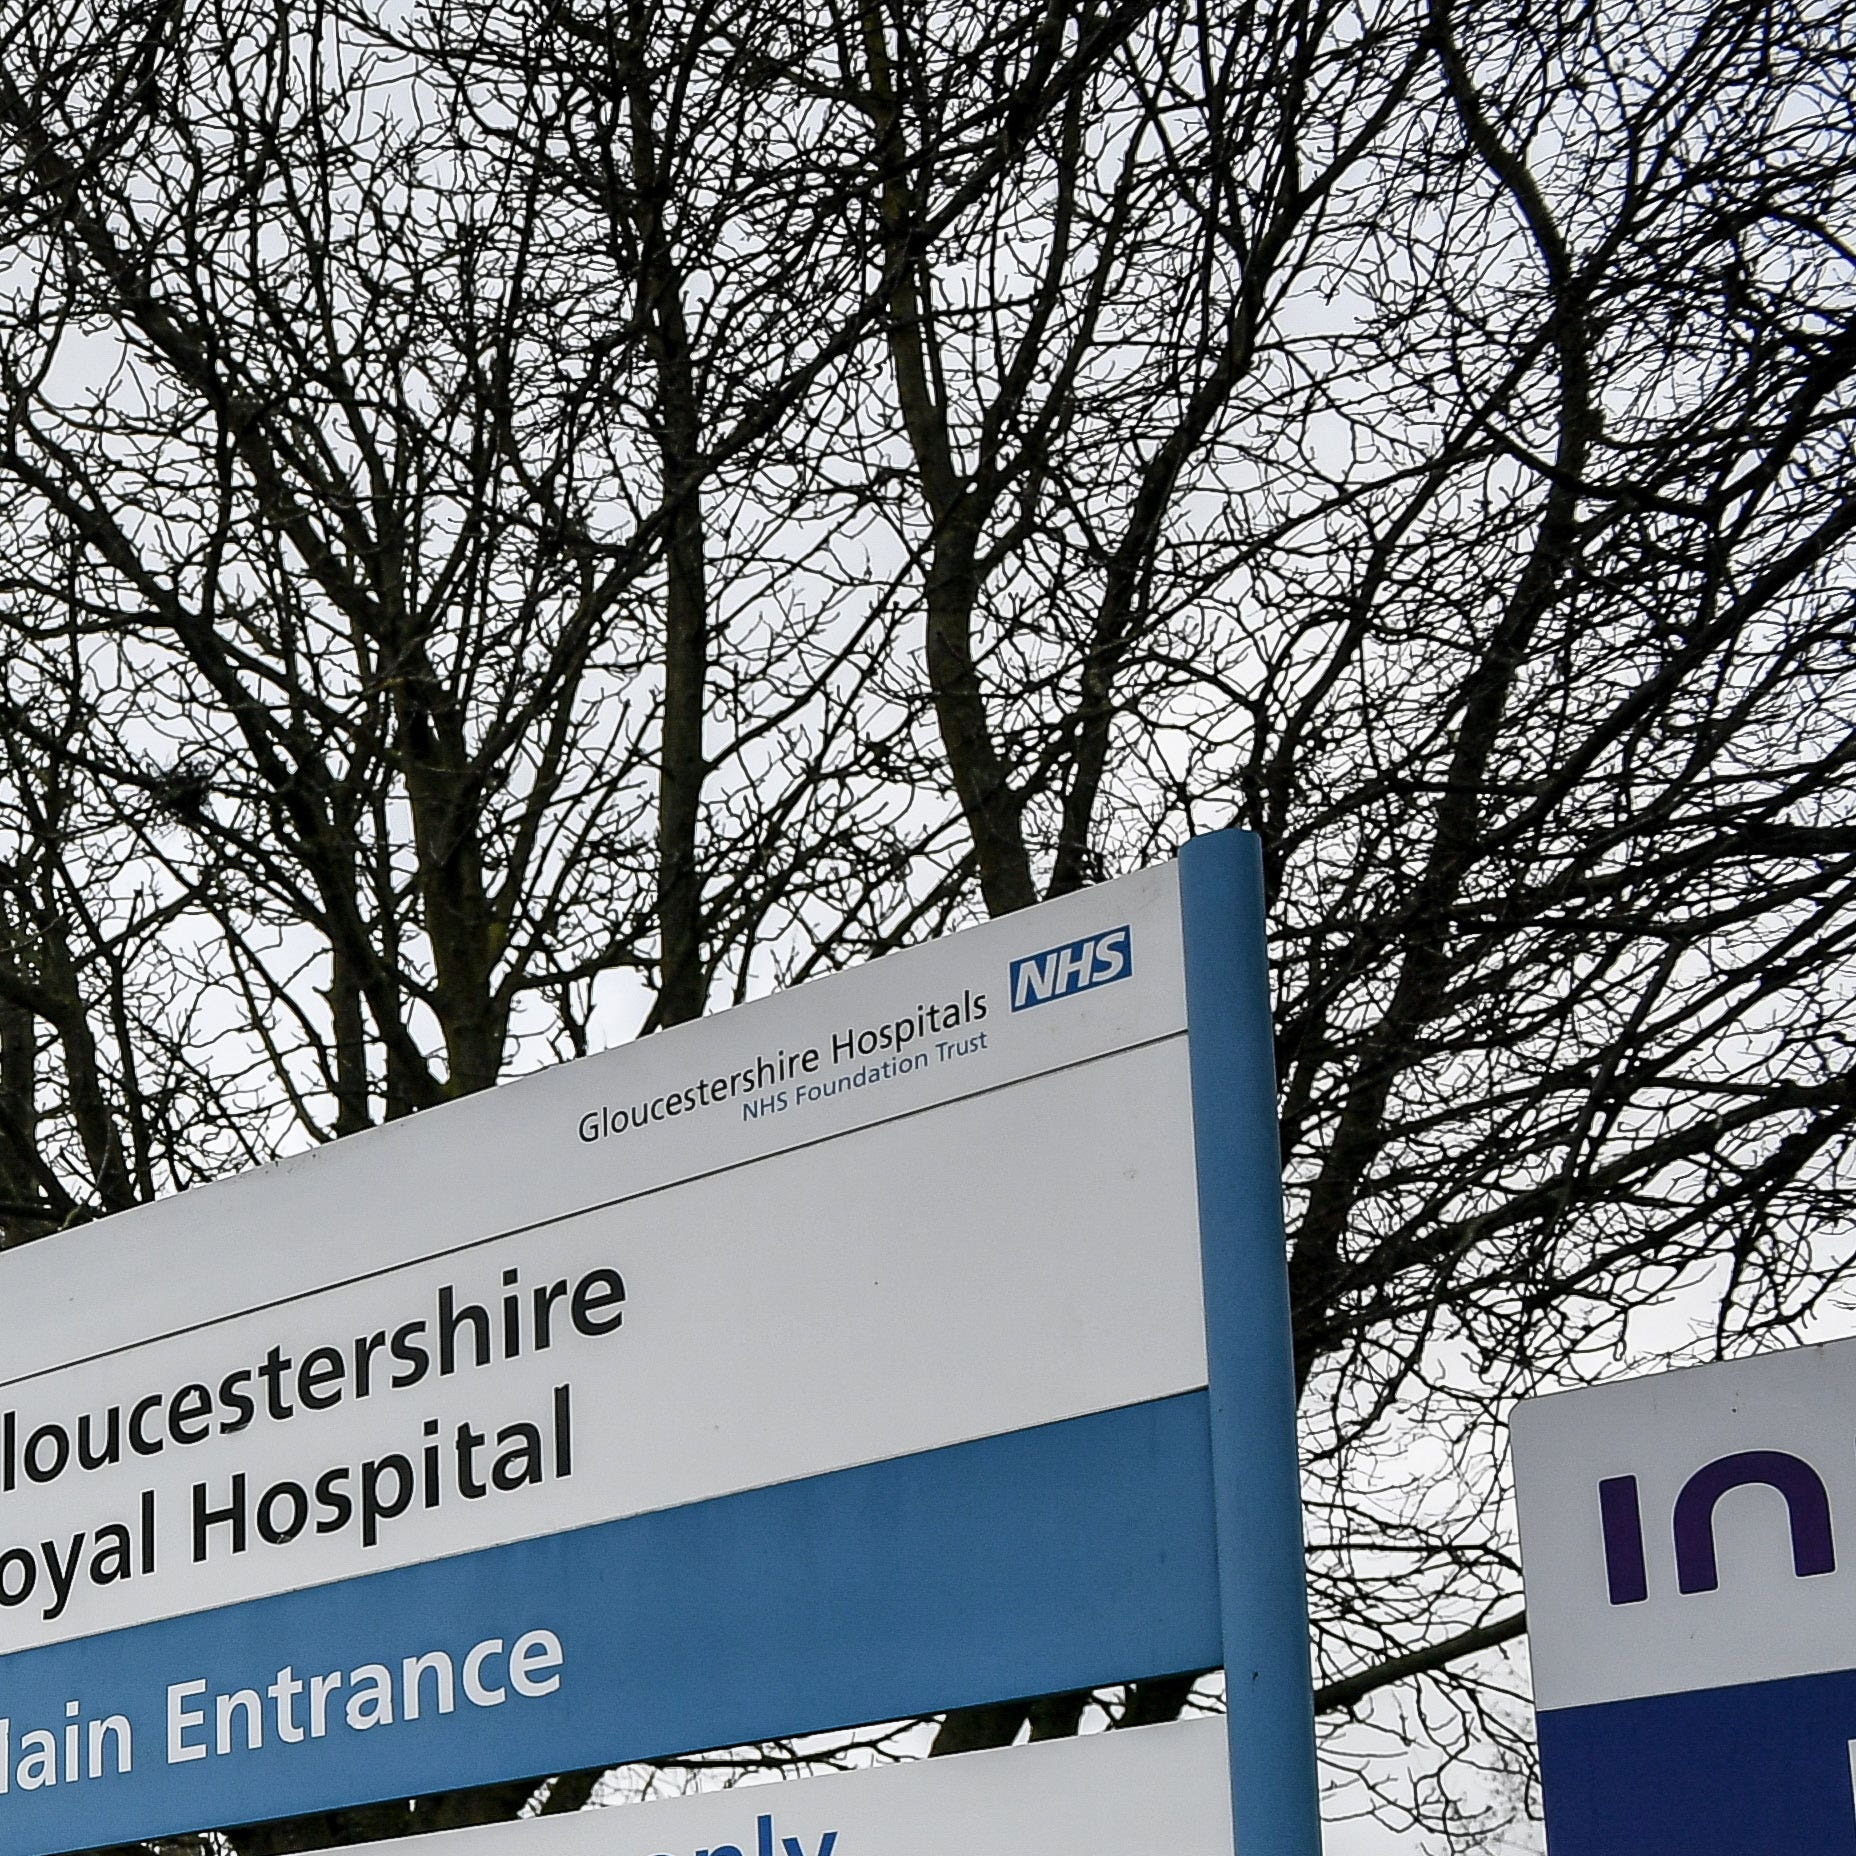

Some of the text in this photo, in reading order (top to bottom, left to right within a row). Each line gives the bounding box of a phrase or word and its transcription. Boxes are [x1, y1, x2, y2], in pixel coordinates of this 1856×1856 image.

[1014, 931, 1126, 1008] NHS
[578, 990, 988, 1144] Gloucestershire Hospitals
[742, 1032, 989, 1121] NHS Foundation Trust
[191, 1382, 573, 1550] Hospital
[164, 1627, 565, 1767] Entrance
